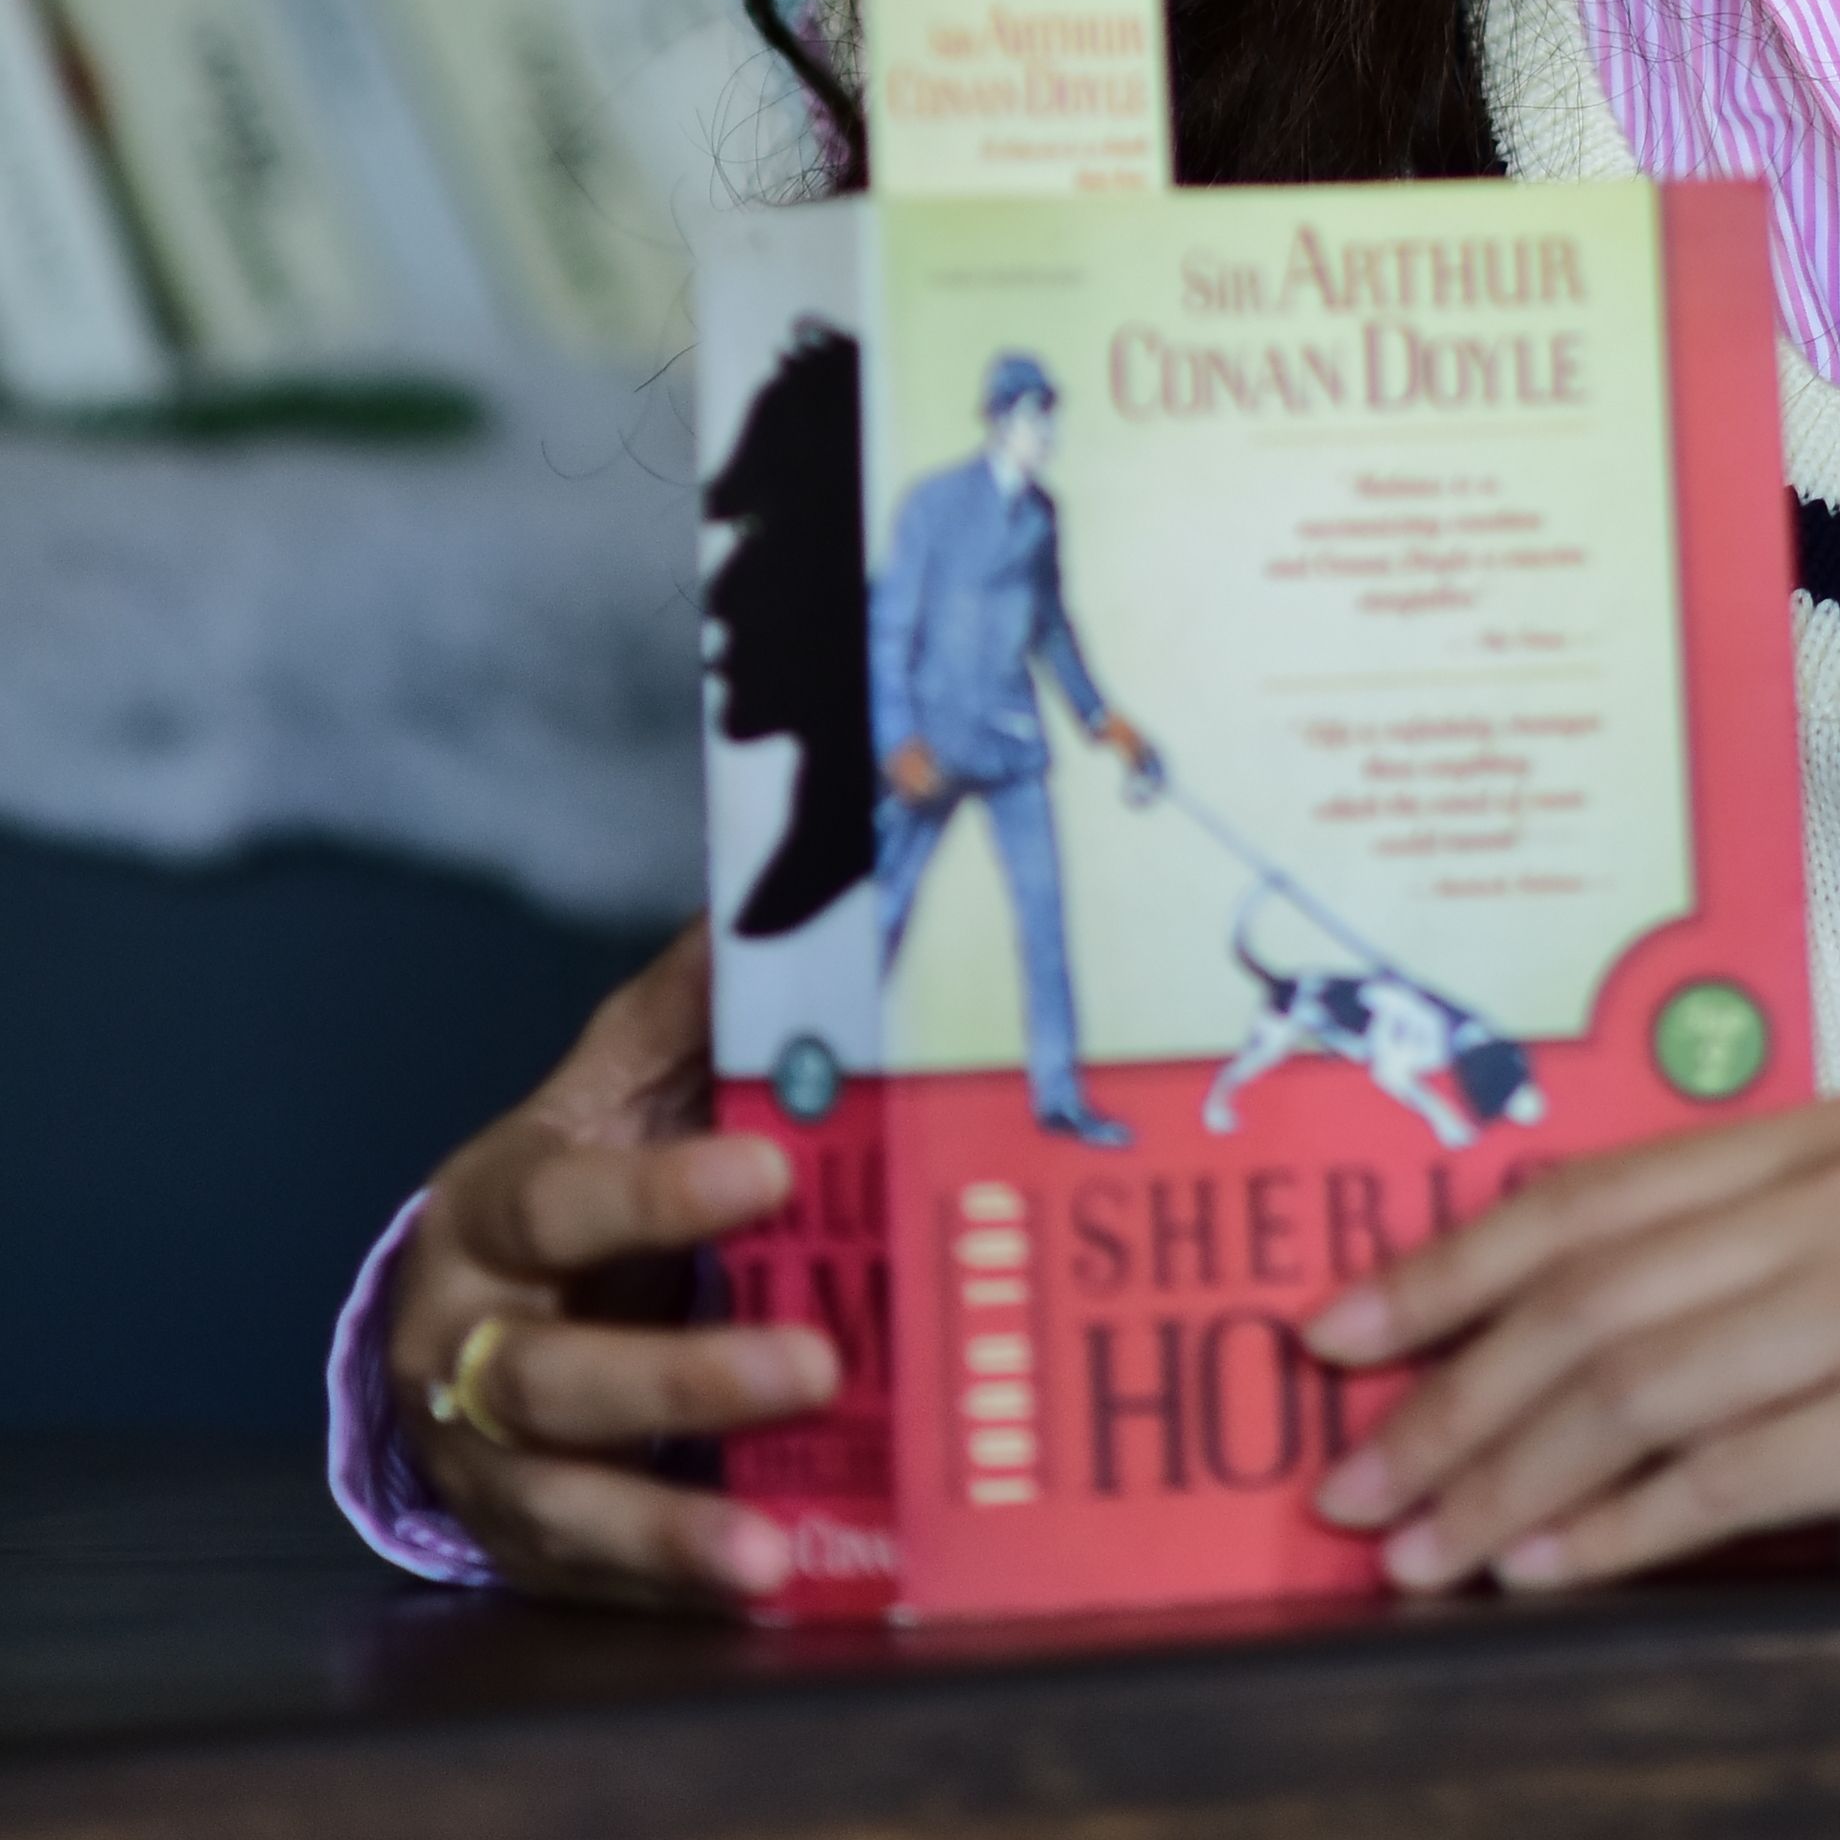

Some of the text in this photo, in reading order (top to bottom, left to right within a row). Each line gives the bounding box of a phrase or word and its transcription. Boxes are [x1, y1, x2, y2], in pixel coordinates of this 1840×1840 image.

[1272, 222, 1588, 316] ARTHUR
[1106, 316, 1588, 426] CONAN DOYLE
